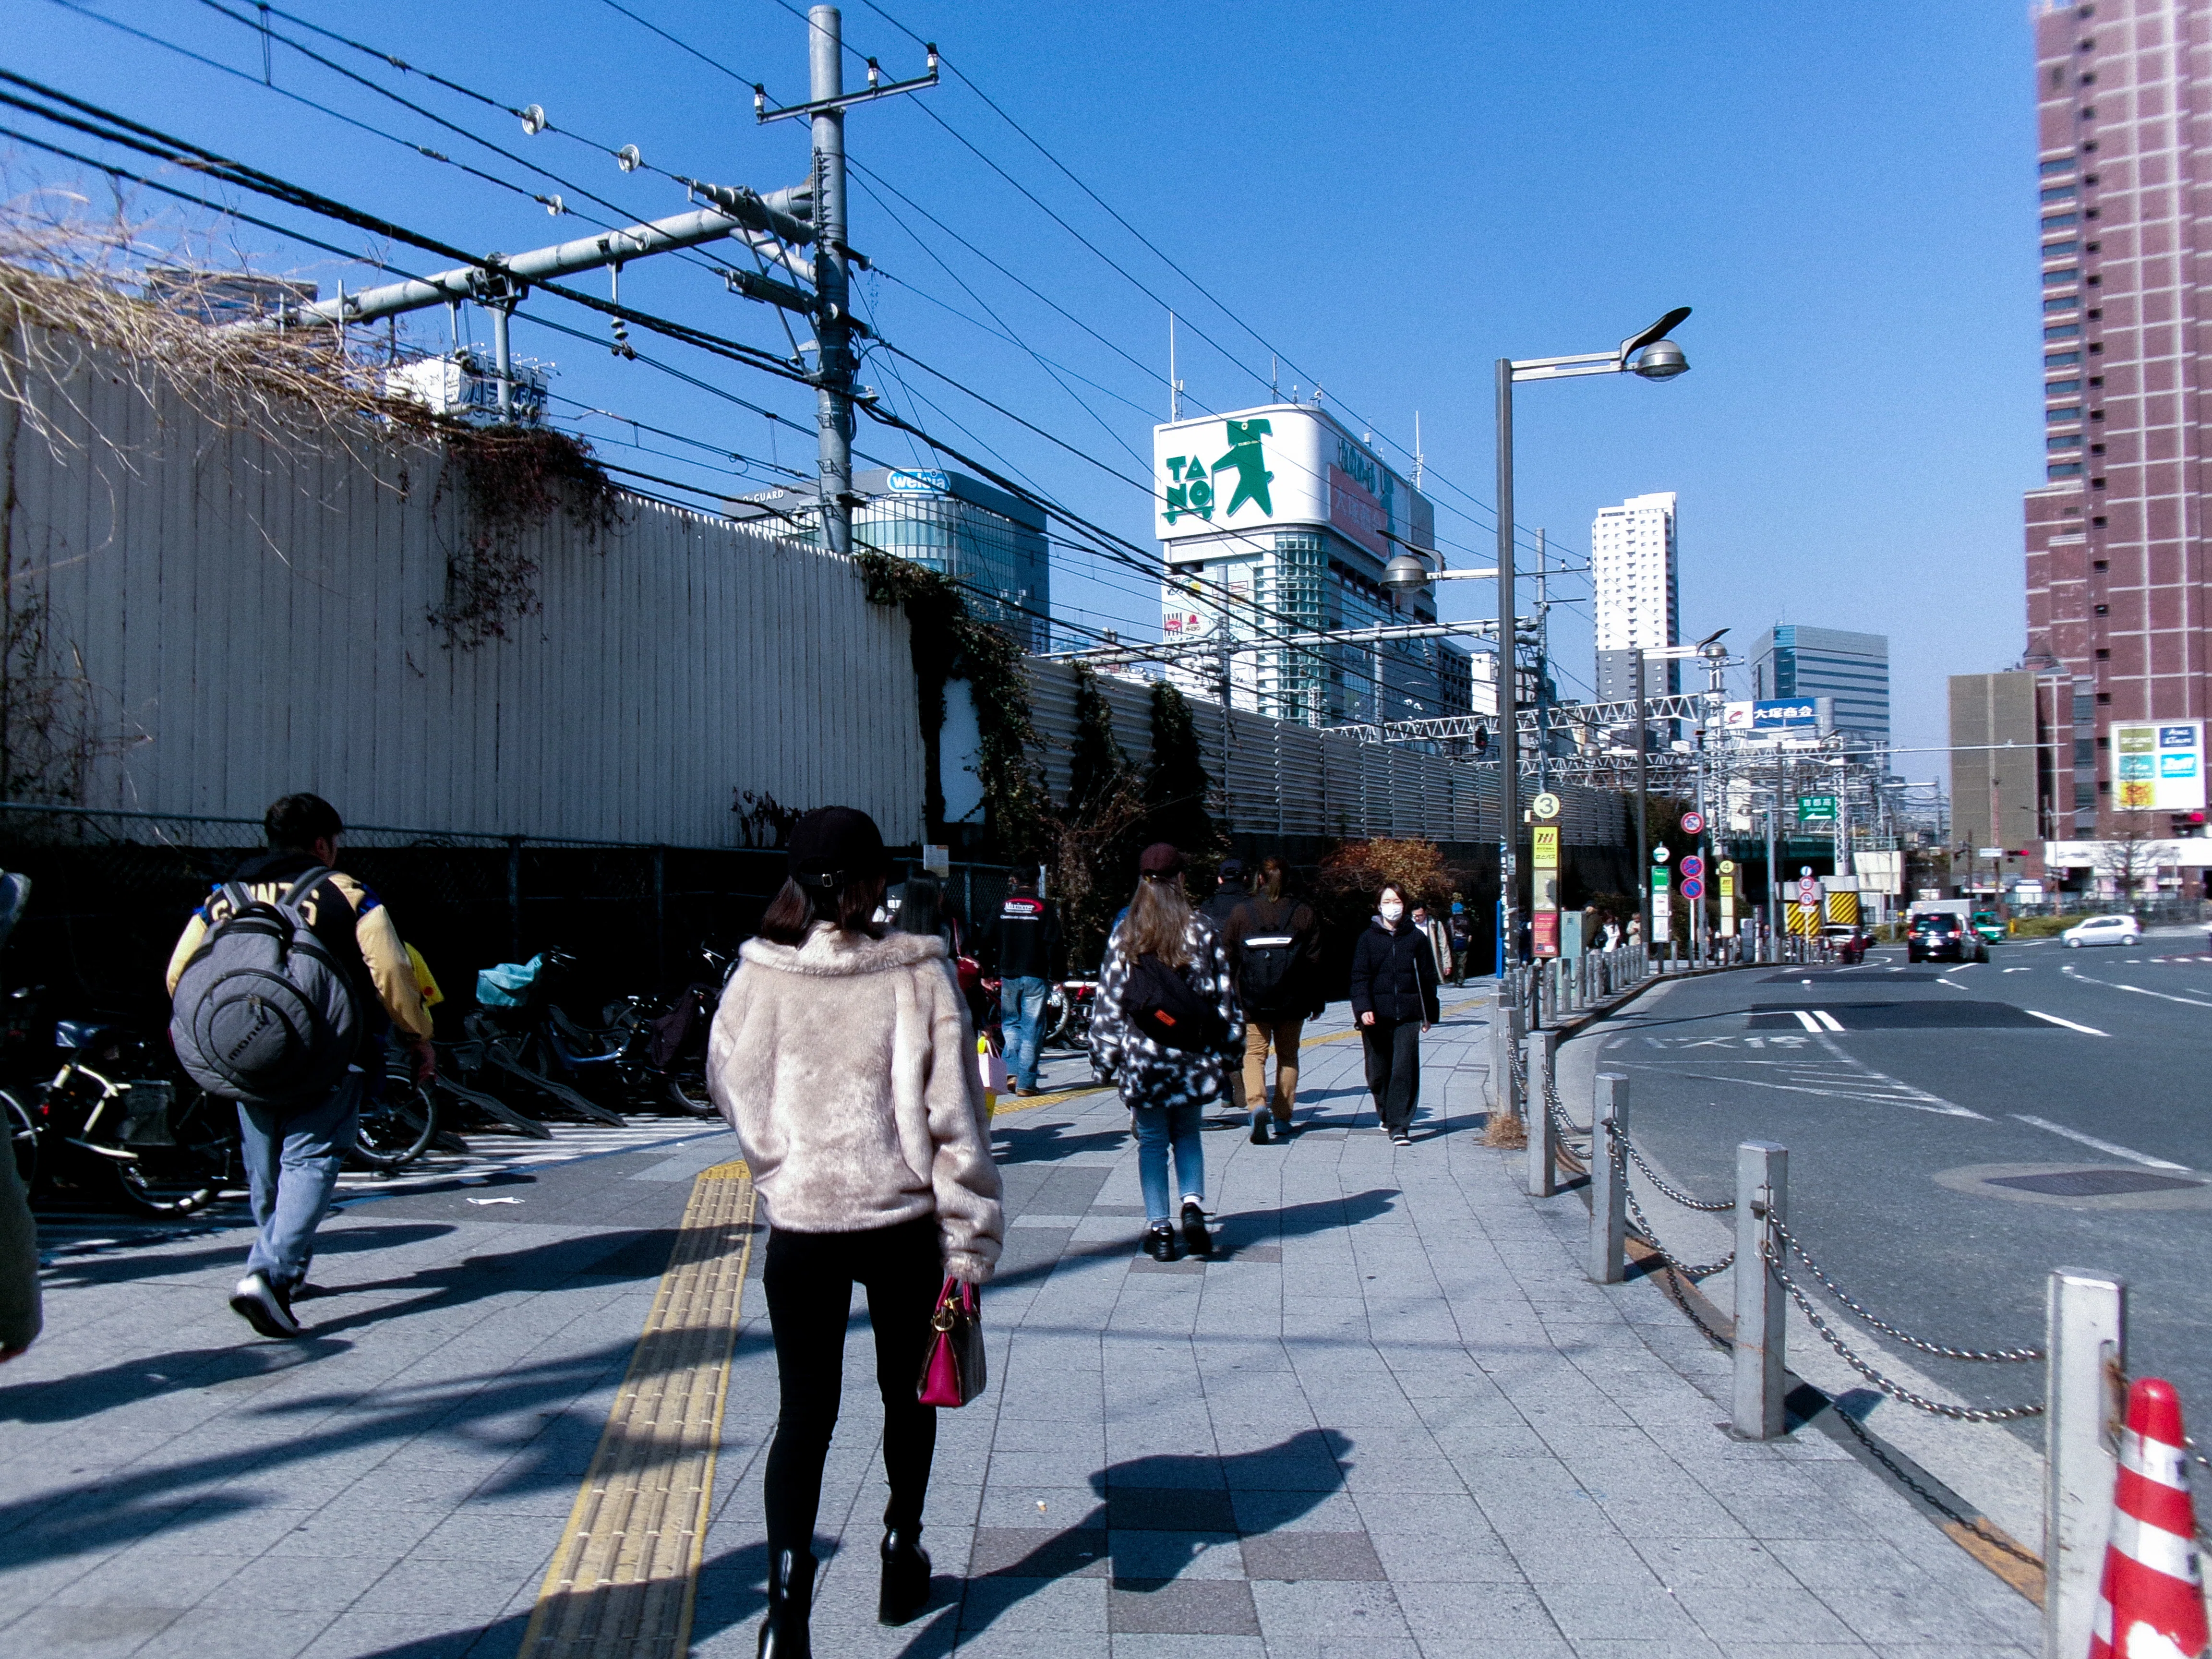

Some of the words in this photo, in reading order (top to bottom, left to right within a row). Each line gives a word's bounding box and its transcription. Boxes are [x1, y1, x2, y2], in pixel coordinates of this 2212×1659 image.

[1754, 706, 1813, 719] 大塚商会
[1539, 797, 1554, 814] 3
[1722, 863, 1731, 871] 4
